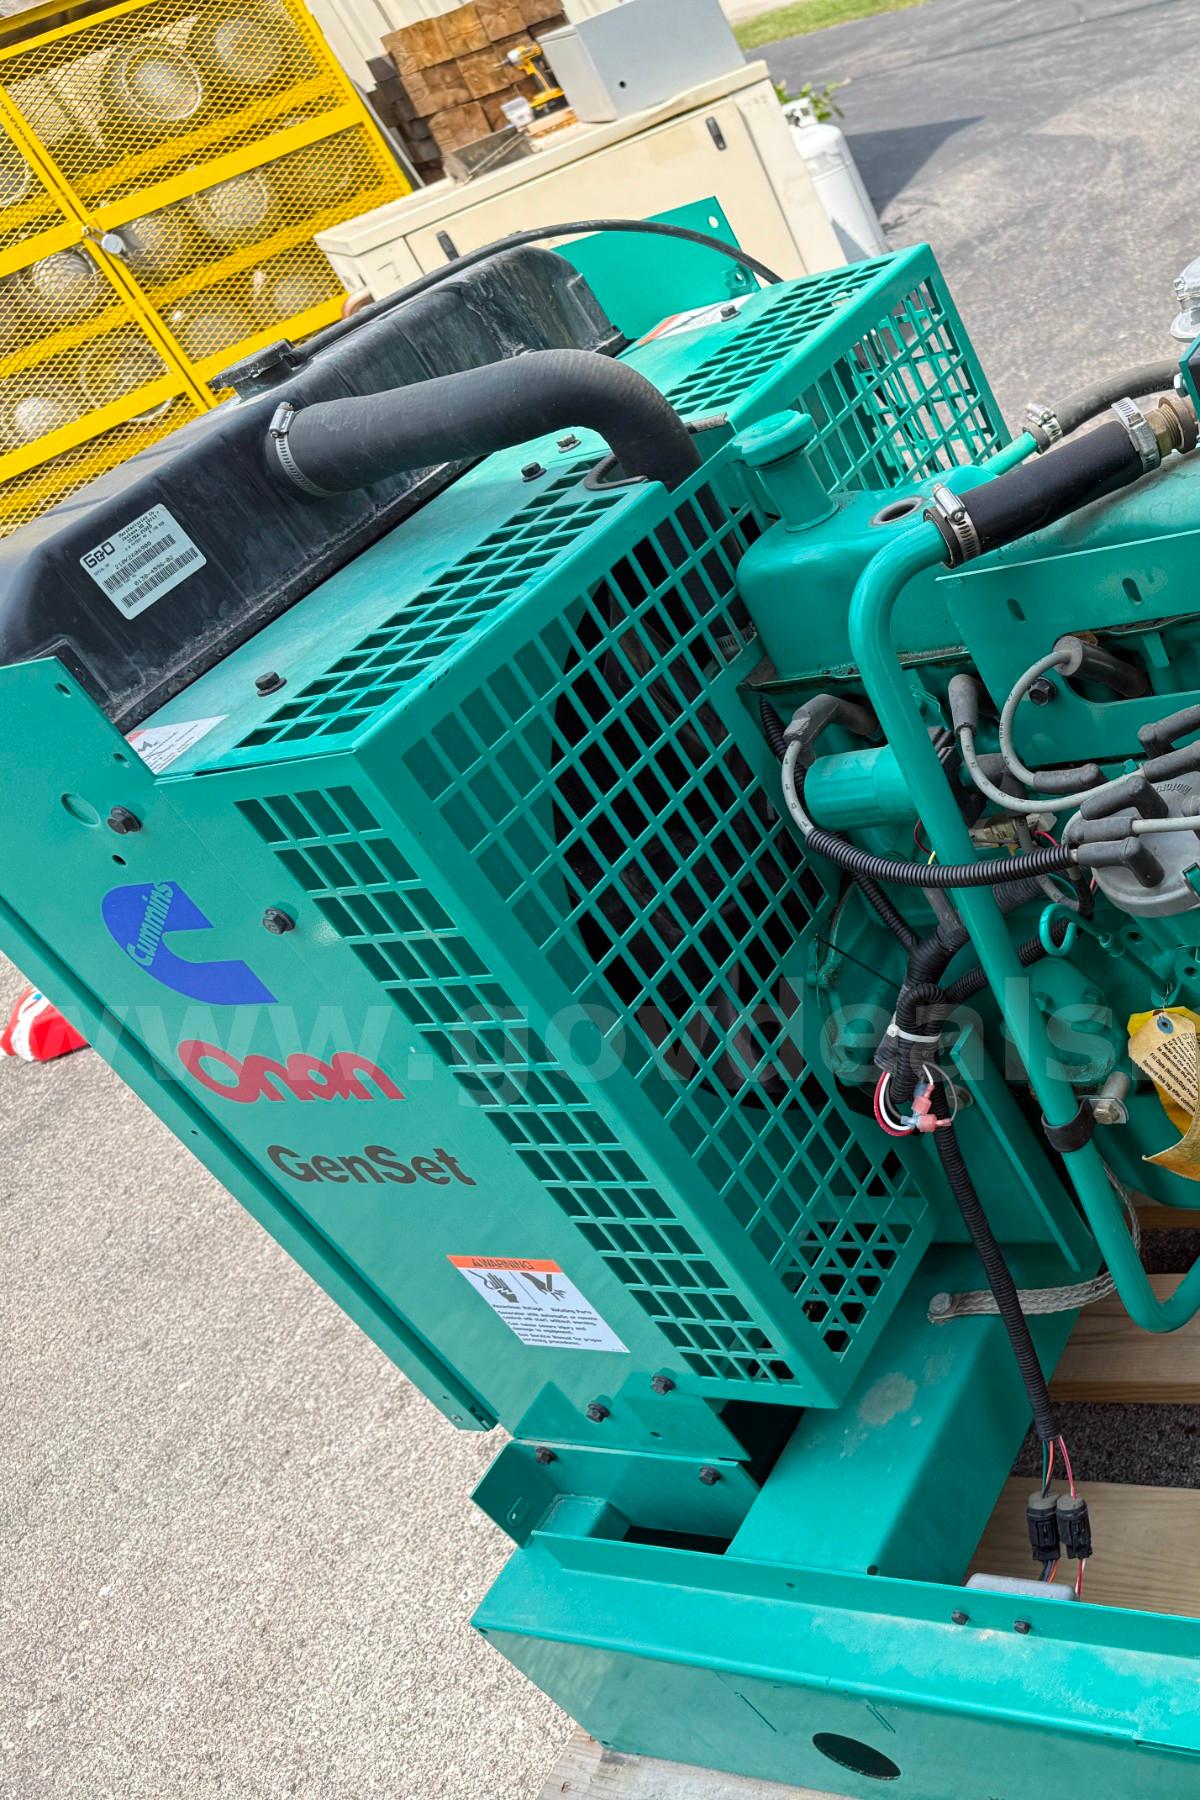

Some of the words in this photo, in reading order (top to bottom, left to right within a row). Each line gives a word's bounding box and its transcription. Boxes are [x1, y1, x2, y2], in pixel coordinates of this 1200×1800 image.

[127, 883, 173, 966] Cummins
[177, 1040, 406, 1103] Onan
[266, 1144, 477, 1187] GenSet
[479, 1259, 534, 1270] WARNING
